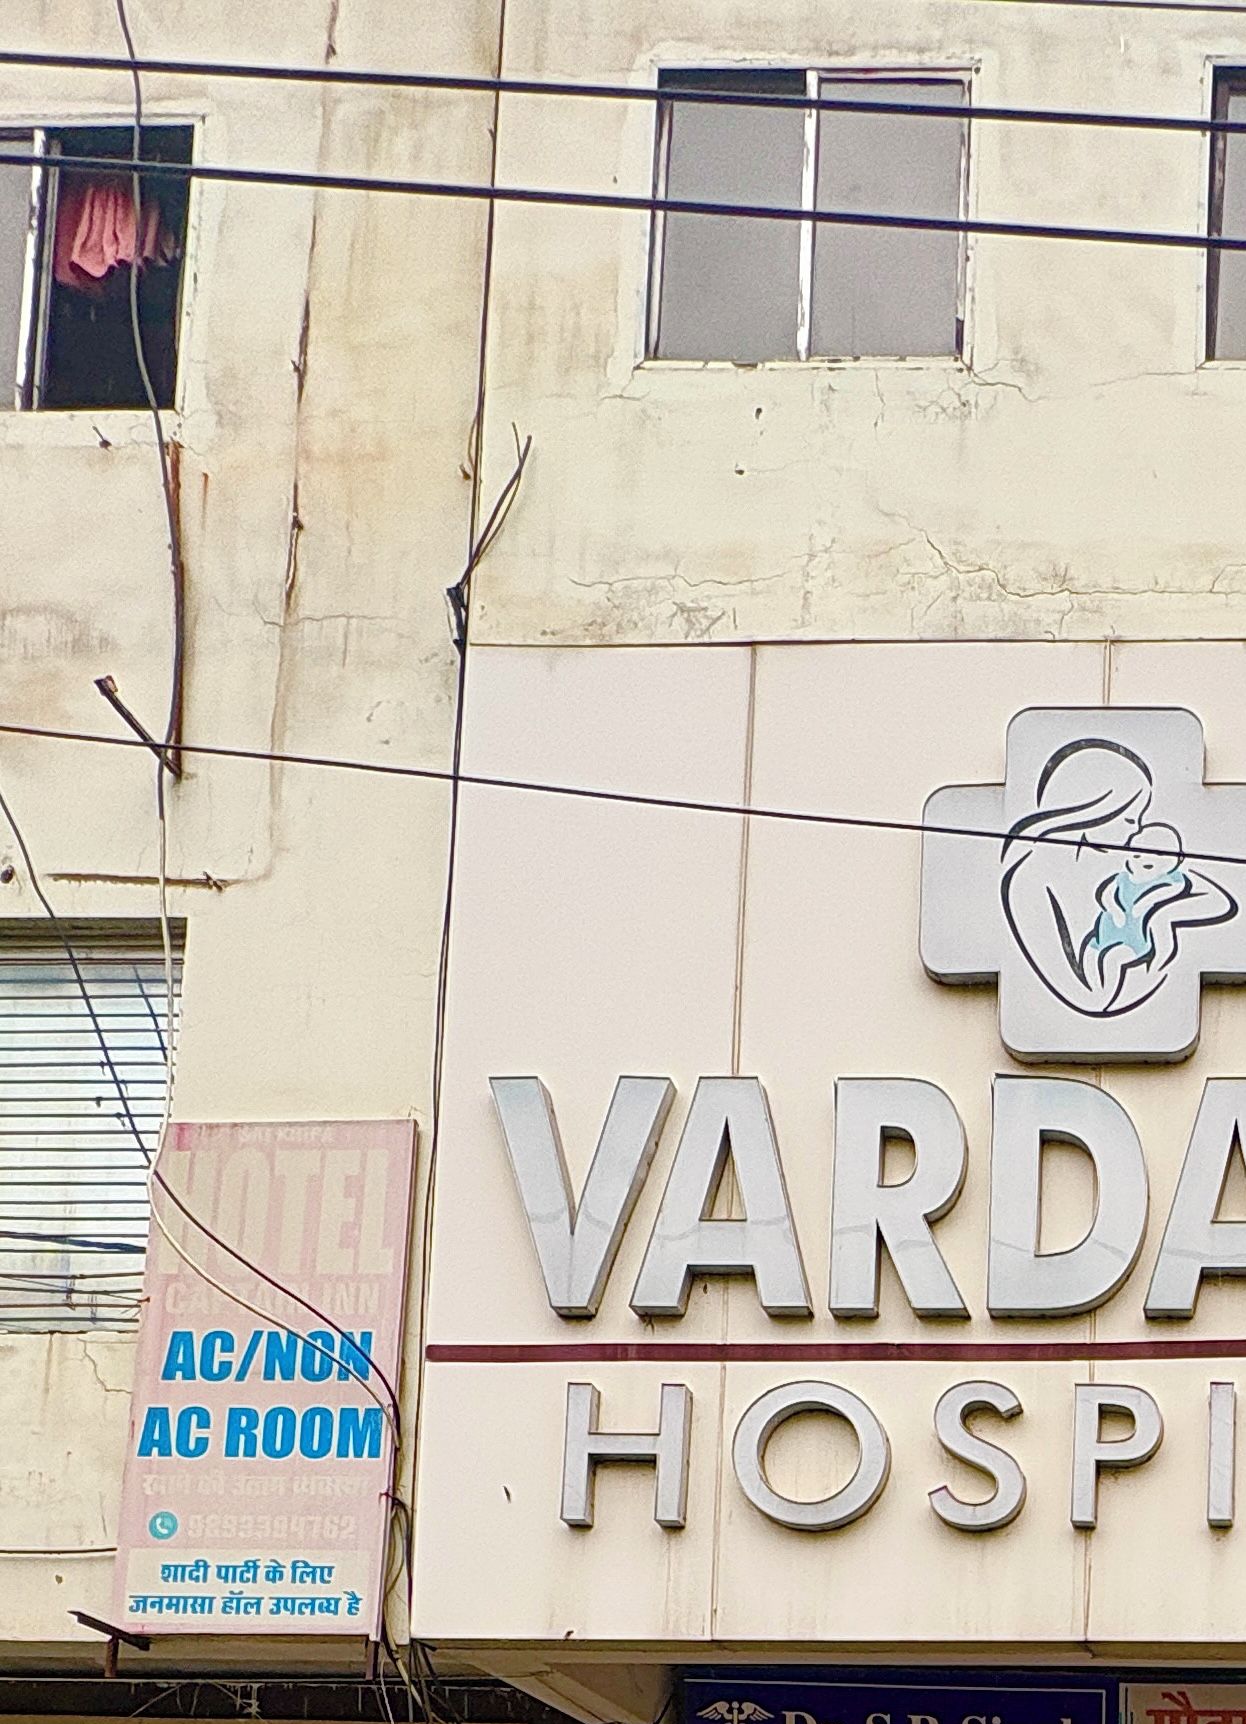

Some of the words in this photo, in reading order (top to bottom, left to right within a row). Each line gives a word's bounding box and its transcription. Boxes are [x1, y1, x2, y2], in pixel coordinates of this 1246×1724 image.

[156, 1148, 394, 1276] HOTEL
[161, 1330, 373, 1382] AC/NON
[138, 1406, 210, 1458] AC
[224, 1406, 384, 1459] ROOM
[160, 1558, 211, 1584] शादी
[216, 1558, 261, 1584] पार्टी
[264, 1558, 287, 1584] के
[290, 1559, 336, 1585] लिए
[128, 1594, 217, 1615] जनमासा
[220, 1590, 265, 1616] हॉल
[345, 1590, 363, 1616] है
